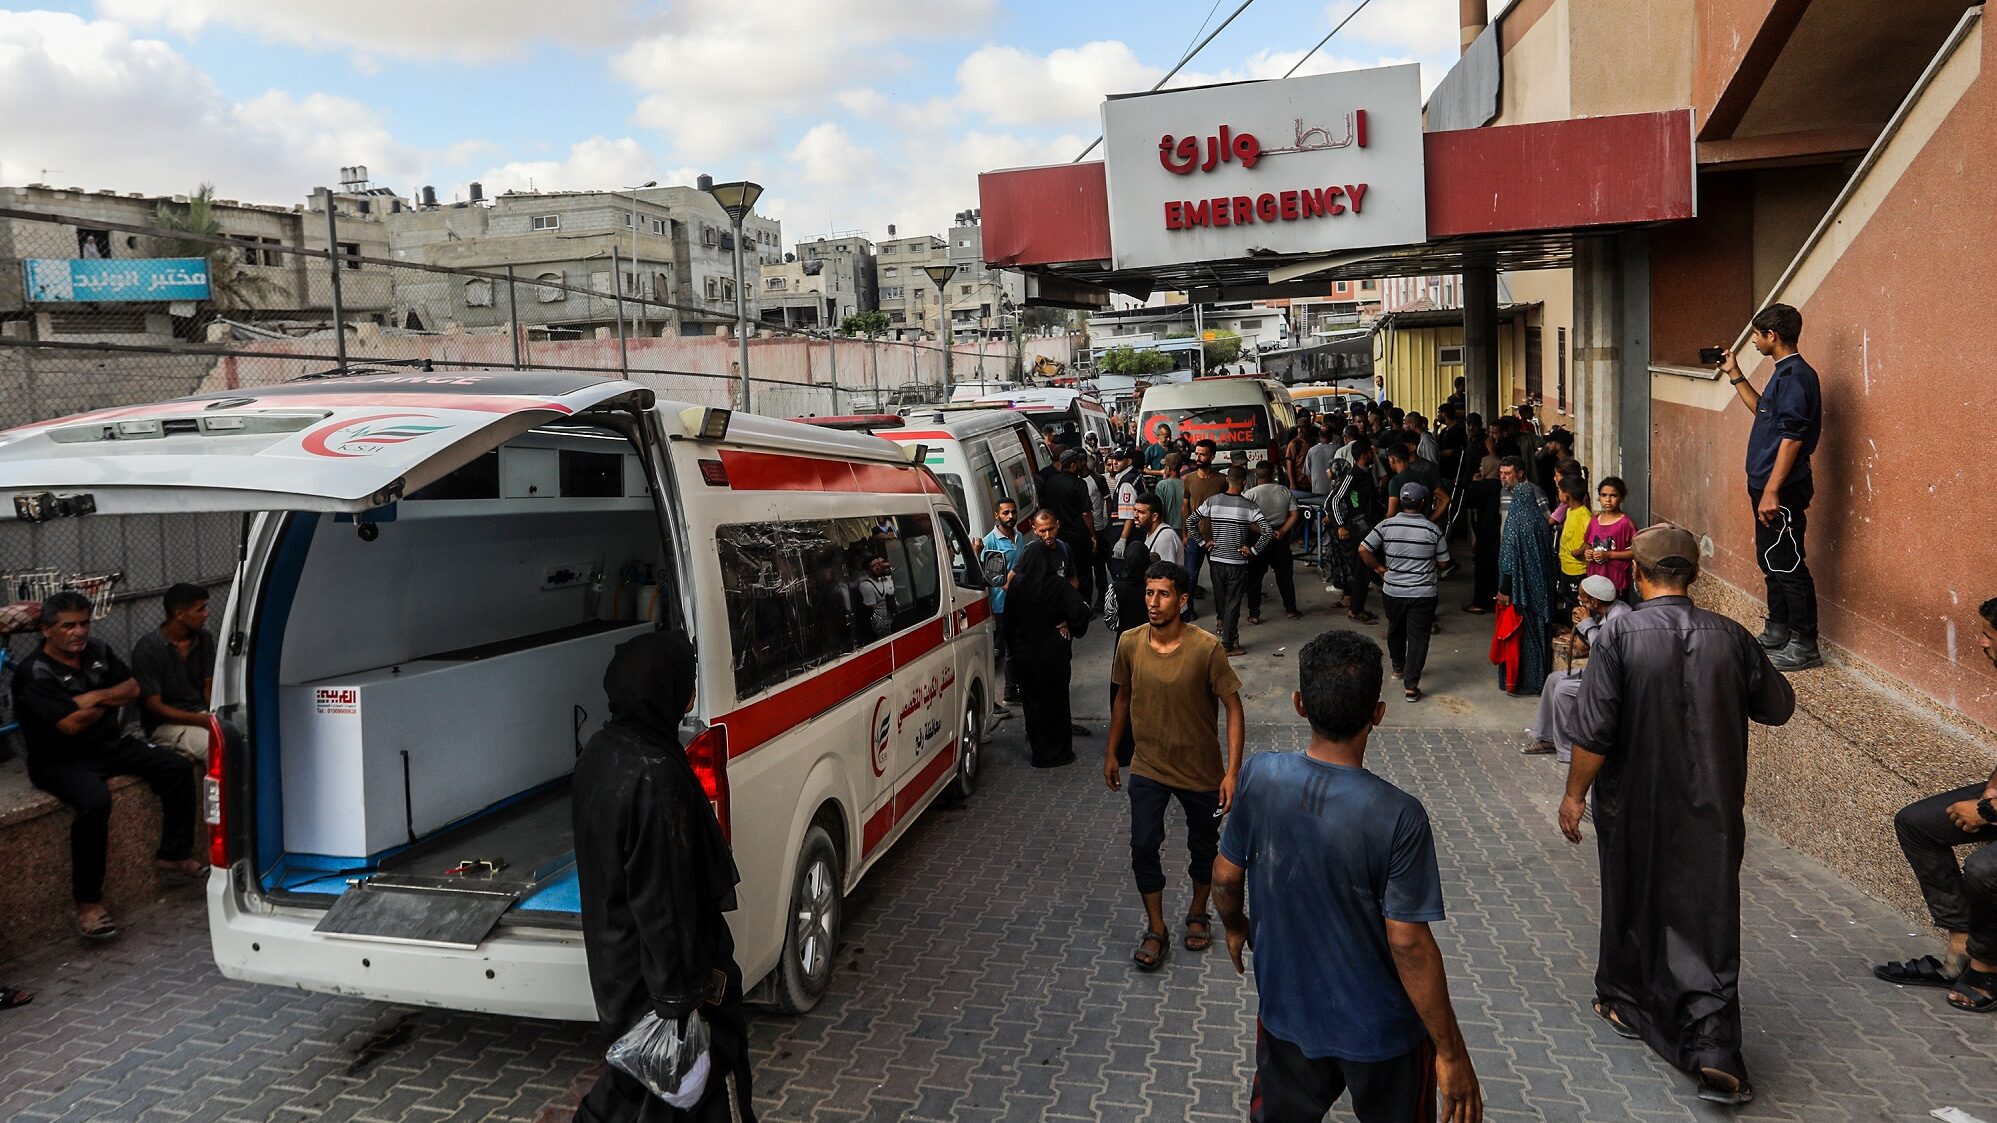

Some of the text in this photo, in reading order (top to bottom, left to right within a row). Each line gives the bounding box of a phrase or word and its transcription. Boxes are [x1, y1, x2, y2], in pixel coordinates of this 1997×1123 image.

[1158, 109, 1367, 174] الطوارئ
[1164, 183, 1368, 231] EMERGENCY
[73, 268, 206, 292] مختبر الوليد
